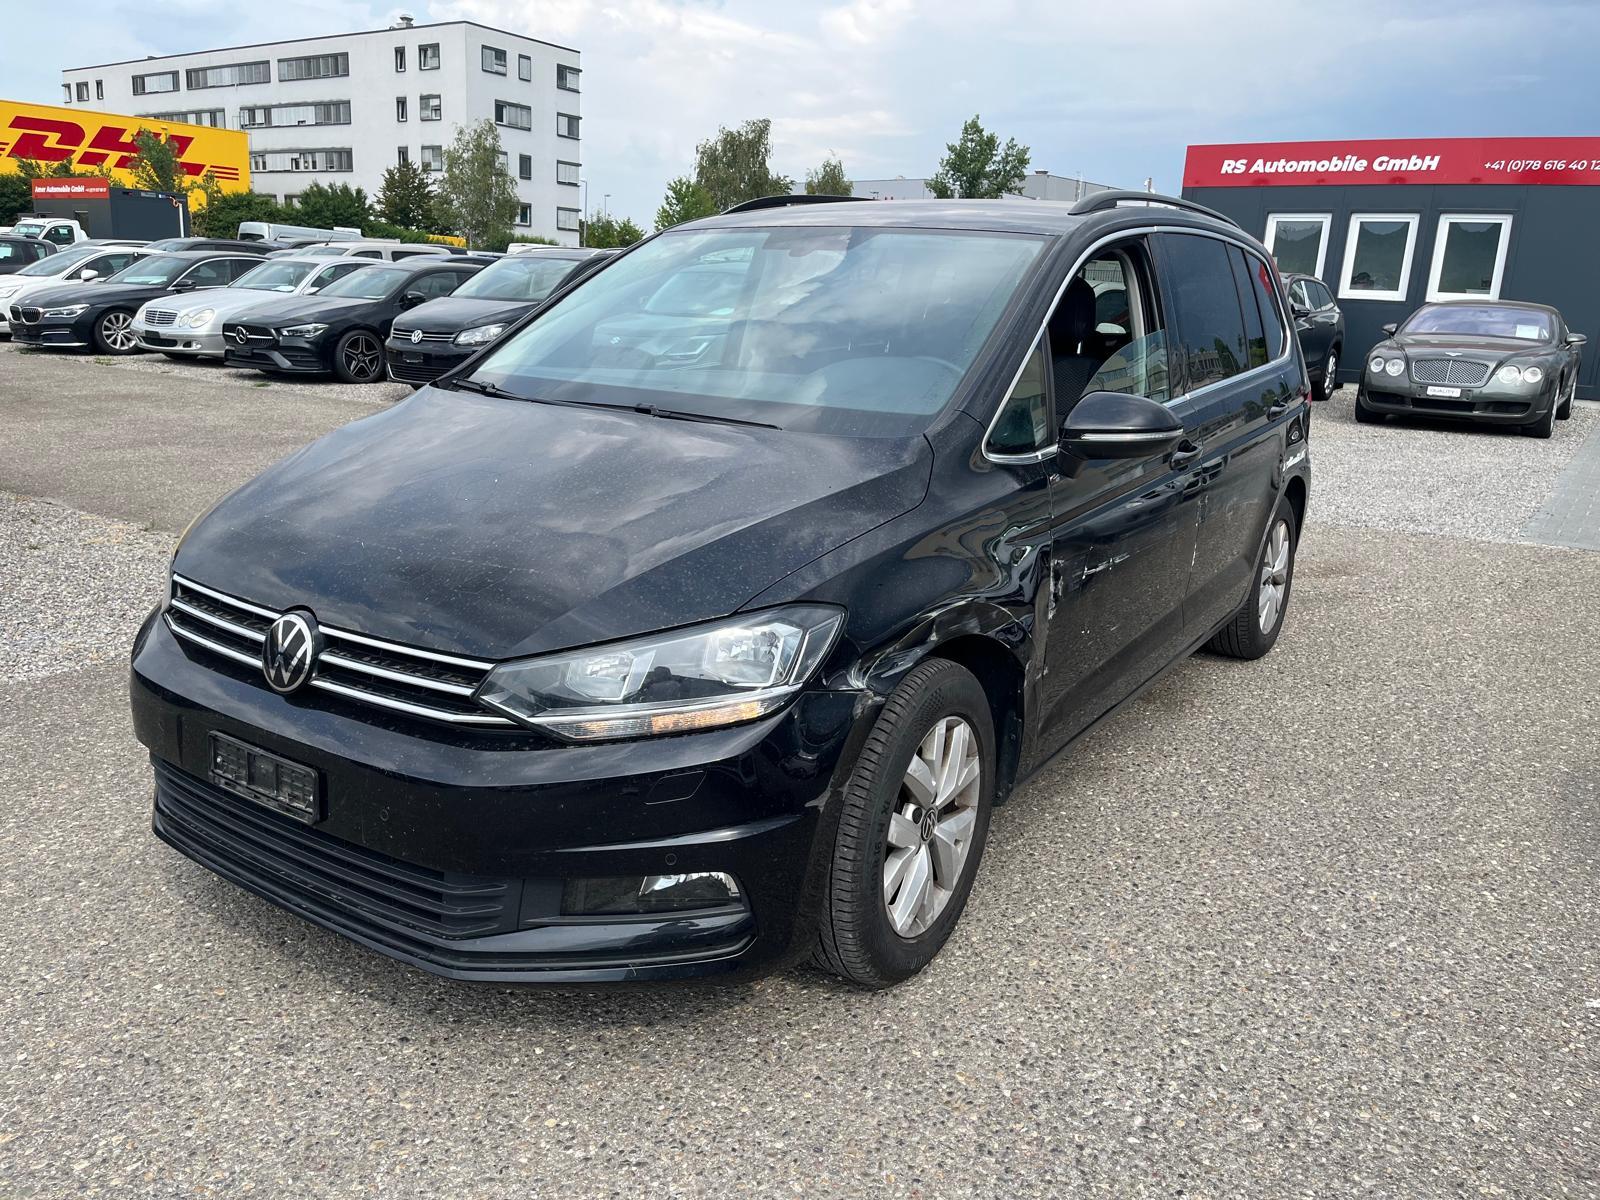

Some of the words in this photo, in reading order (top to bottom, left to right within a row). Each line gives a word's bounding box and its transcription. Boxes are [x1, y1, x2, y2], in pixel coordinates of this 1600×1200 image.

[6, 115, 206, 176] DHL
[1220, 159, 1248, 174] RS
[1248, 155, 1368, 174] Automobile
[1372, 155, 1441, 172] GmbH
[1484, 160, 1505, 171] +41
[1507, 159, 1541, 173] (0)78
[1543, 160, 1566, 171] 616
[1568, 160, 1588, 171] 40
[46, 185, 71, 193] Automobile
[71, 185, 85, 193] GmbH
